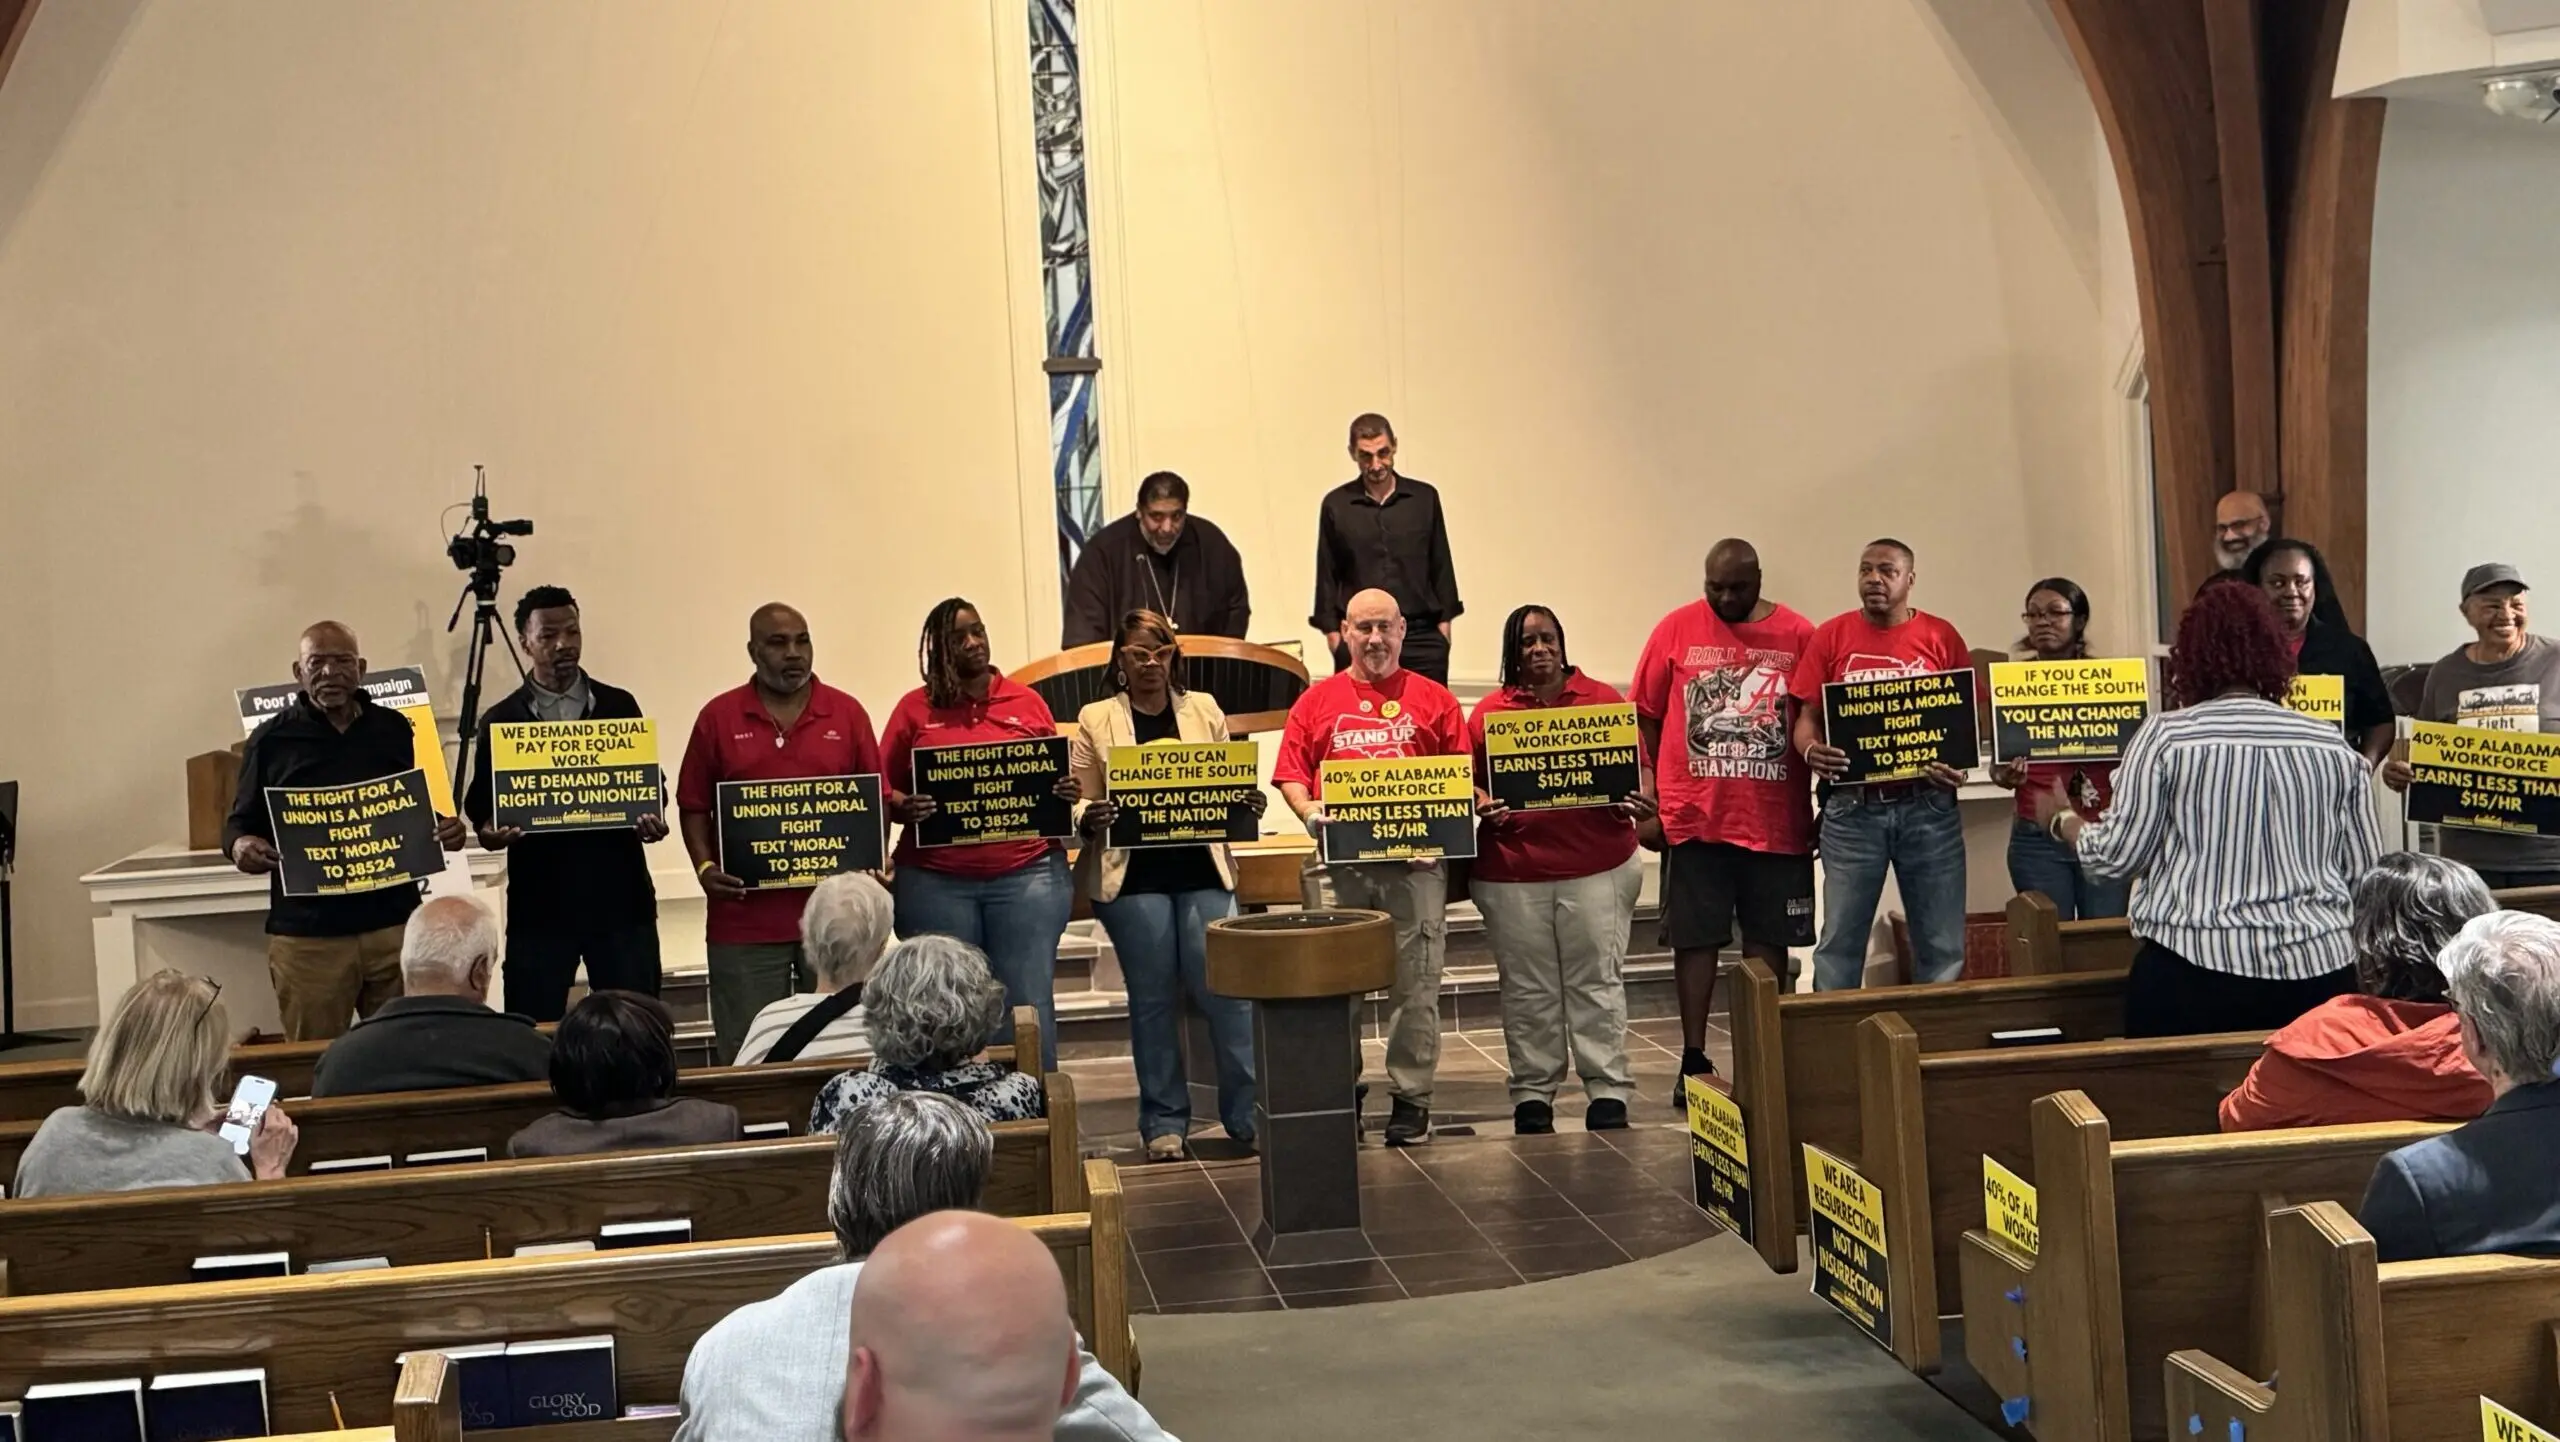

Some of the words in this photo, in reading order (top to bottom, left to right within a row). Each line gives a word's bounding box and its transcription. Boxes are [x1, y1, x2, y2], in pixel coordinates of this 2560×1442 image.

[2025, 670, 2037, 682] IF
[2042, 669, 2074, 681] YOU
[2079, 668, 2112, 680] CAN
[253, 696, 284, 711] Poor
[360, 679, 412, 695] mpaign
[1845, 685, 1870, 699] THE
[1874, 681, 1912, 696] FIGHT
[1915, 677, 1940, 691] FOR
[1944, 676, 1954, 688] A
[1995, 684, 2058, 698] CHANGE
[2062, 683, 2089, 695] THE
[2095, 681, 2145, 694] SOUTH
[1839, 701, 1884, 717] UNION
[1888, 700, 1900, 713] IS
[1903, 698, 1913, 710] A
[1916, 692, 1963, 709] MORAL
[2292, 699, 2341, 711] OUTH
[1884, 714, 1922, 730] FIGHT
[2002, 709, 2035, 724] YOU
[2039, 708, 2072, 722] CAN
[2076, 705, 2141, 721] CHANGE
[501, 727, 525, 739] WE
[530, 724, 594, 738] DEMAND
[599, 722, 648, 735] EQUAL
[1487, 722, 1520, 735] 40%
[1524, 721, 1544, 733] OF
[1549, 714, 1635, 731] ALABAMA'S
[2026, 726, 2055, 739] THE
[2059, 723, 2118, 738] NATION
[516, 741, 546, 754] PAY
[551, 740, 581, 752] FOR
[586, 737, 635, 752] EQUAL
[1333, 731, 1388, 748] STAND
[1392, 728, 1415, 741] UP
[1514, 731, 1610, 748] WORKFORCE
[1857, 736, 1890, 750] TEXT
[2412, 732, 2448, 747] 40%
[2453, 737, 2475, 749] OF
[2480, 739, 2560, 757] ALABAMA
[552, 754, 599, 767] WORK
[934, 751, 960, 763] THE
[964, 747, 1004, 760] FIGHT
[1007, 745, 1034, 757] FOR
[1038, 743, 1048, 754] A
[1141, 753, 1152, 765] IF
[1158, 751, 1189, 764] YOU
[1194, 750, 1226, 762] CAN
[1494, 757, 1546, 772] EARNS
[1550, 754, 1587, 769] LESS
[1590, 750, 1634, 766] THAN
[1874, 752, 1893, 766] TO
[1896, 747, 1938, 763] 38524
[2440, 749, 2548, 772] WORKFORCE
[928, 767, 974, 781] UNION
[977, 765, 990, 777] IS
[993, 764, 1004, 776] A
[1007, 760, 1057, 775] MORAL
[1110, 768, 1172, 781] CHANGE
[1177, 767, 1202, 779] THE
[1208, 764, 1257, 777] SOUTH
[1324, 772, 1356, 784] 40%
[1361, 770, 1380, 782] OF
[1385, 766, 1470, 781] ALABAMA'S
[1689, 760, 1787, 781] CHAMPIONS
[510, 775, 536, 790] WE
[541, 772, 610, 788] DEMAND
[614, 770, 644, 784] THE
[974, 780, 1013, 794] FIGHT
[1538, 771, 1593, 789] $15/HR
[2415, 768, 2472, 787] EARNS
[2477, 775, 2517, 793] LESS
[2522, 780, 2560, 797] THA
[285, 793, 311, 806] THE
[313, 790, 355, 806] FIGHT
[358, 783, 390, 801] FOR
[393, 780, 405, 793] A
[499, 792, 547, 808] RIGHT
[551, 791, 574, 805] TO
[578, 787, 657, 804] UNIONIZE
[741, 786, 767, 799] THE
[771, 783, 812, 798] FIGHT
[815, 782, 844, 795] FOR
[847, 781, 858, 793] A
[1116, 794, 1148, 807] YOU
[1153, 792, 1184, 806] CAN
[1189, 790, 1241, 803] CHANG
[1350, 782, 1445, 798] WORKFORCE
[282, 811, 327, 824] UNION
[330, 809, 344, 823] IS
[348, 809, 360, 821] A
[362, 794, 417, 819] MORAL
[733, 804, 781, 818] UNION
[785, 803, 798, 815] IS
[802, 802, 813, 815] A
[816, 799, 867, 813] MORAL
[945, 800, 979, 814] TEXT
[2460, 790, 2522, 812] $15/HR
[1139, 811, 1166, 824] THE
[1170, 807, 1227, 822] NATION
[1385, 805, 1422, 820] LESS
[1425, 803, 1468, 818] THAN
[781, 820, 822, 834] FIGHT
[961, 817, 981, 829] TO
[985, 813, 1029, 828] 38524
[329, 824, 372, 842] FIGHT
[1372, 822, 1428, 840] $15/HR
[304, 847, 337, 860] TEXT
[751, 841, 786, 854] TEXT
[322, 865, 343, 879] TO
[347, 856, 395, 876] 38524
[769, 859, 789, 872] TO
[793, 856, 838, 870] 38524
[1702, 1098, 1709, 1113] OF
[1699, 1115, 1737, 1152] WORKFORCE
[1693, 1138, 1714, 1166] EARNS
[1715, 1152, 1730, 1176] LESS
[1730, 1161, 1748, 1190] THAN
[1822, 1160, 1838, 1189] WE
[1840, 1171, 1857, 1201] ARE
[1859, 1185, 1866, 1207] A
[1986, 1176, 2006, 1206] 40%
[2008, 1190, 2020, 1214] OF
[2024, 1202, 2037, 1227] AL
[1814, 1183, 1880, 1245] RESURRECTION
[2003, 1211, 2038, 1251] WORKF
[1832, 1227, 1851, 1259] NOT
[1854, 1241, 1868, 1271] AN
[1819, 1245, 1883, 1313] INSURRECTION
[529, 1392, 585, 1408] GLORY
[561, 1404, 600, 1417] GOD
